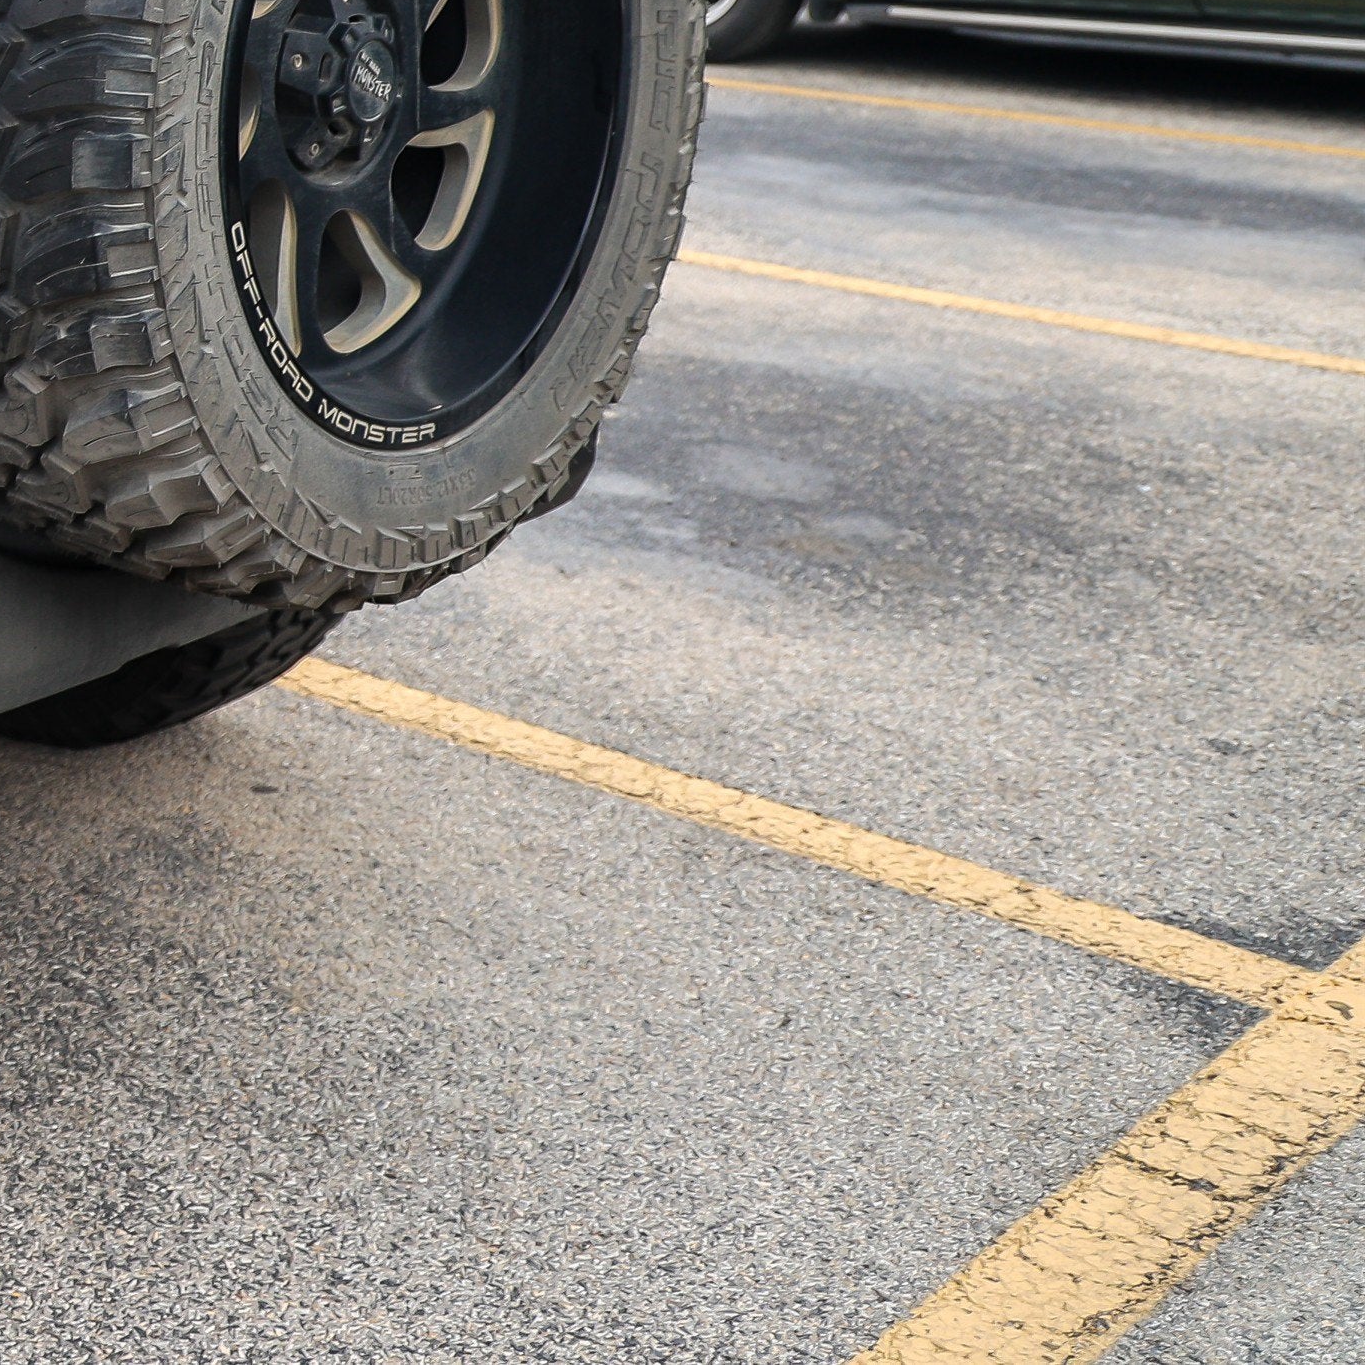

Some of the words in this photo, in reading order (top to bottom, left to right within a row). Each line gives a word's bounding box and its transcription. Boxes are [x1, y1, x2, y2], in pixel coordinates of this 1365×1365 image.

[353, 65, 392, 102] MONSTER
[231, 221, 315, 403] OFF-ROAD
[317, 398, 437, 444] MONSTER
